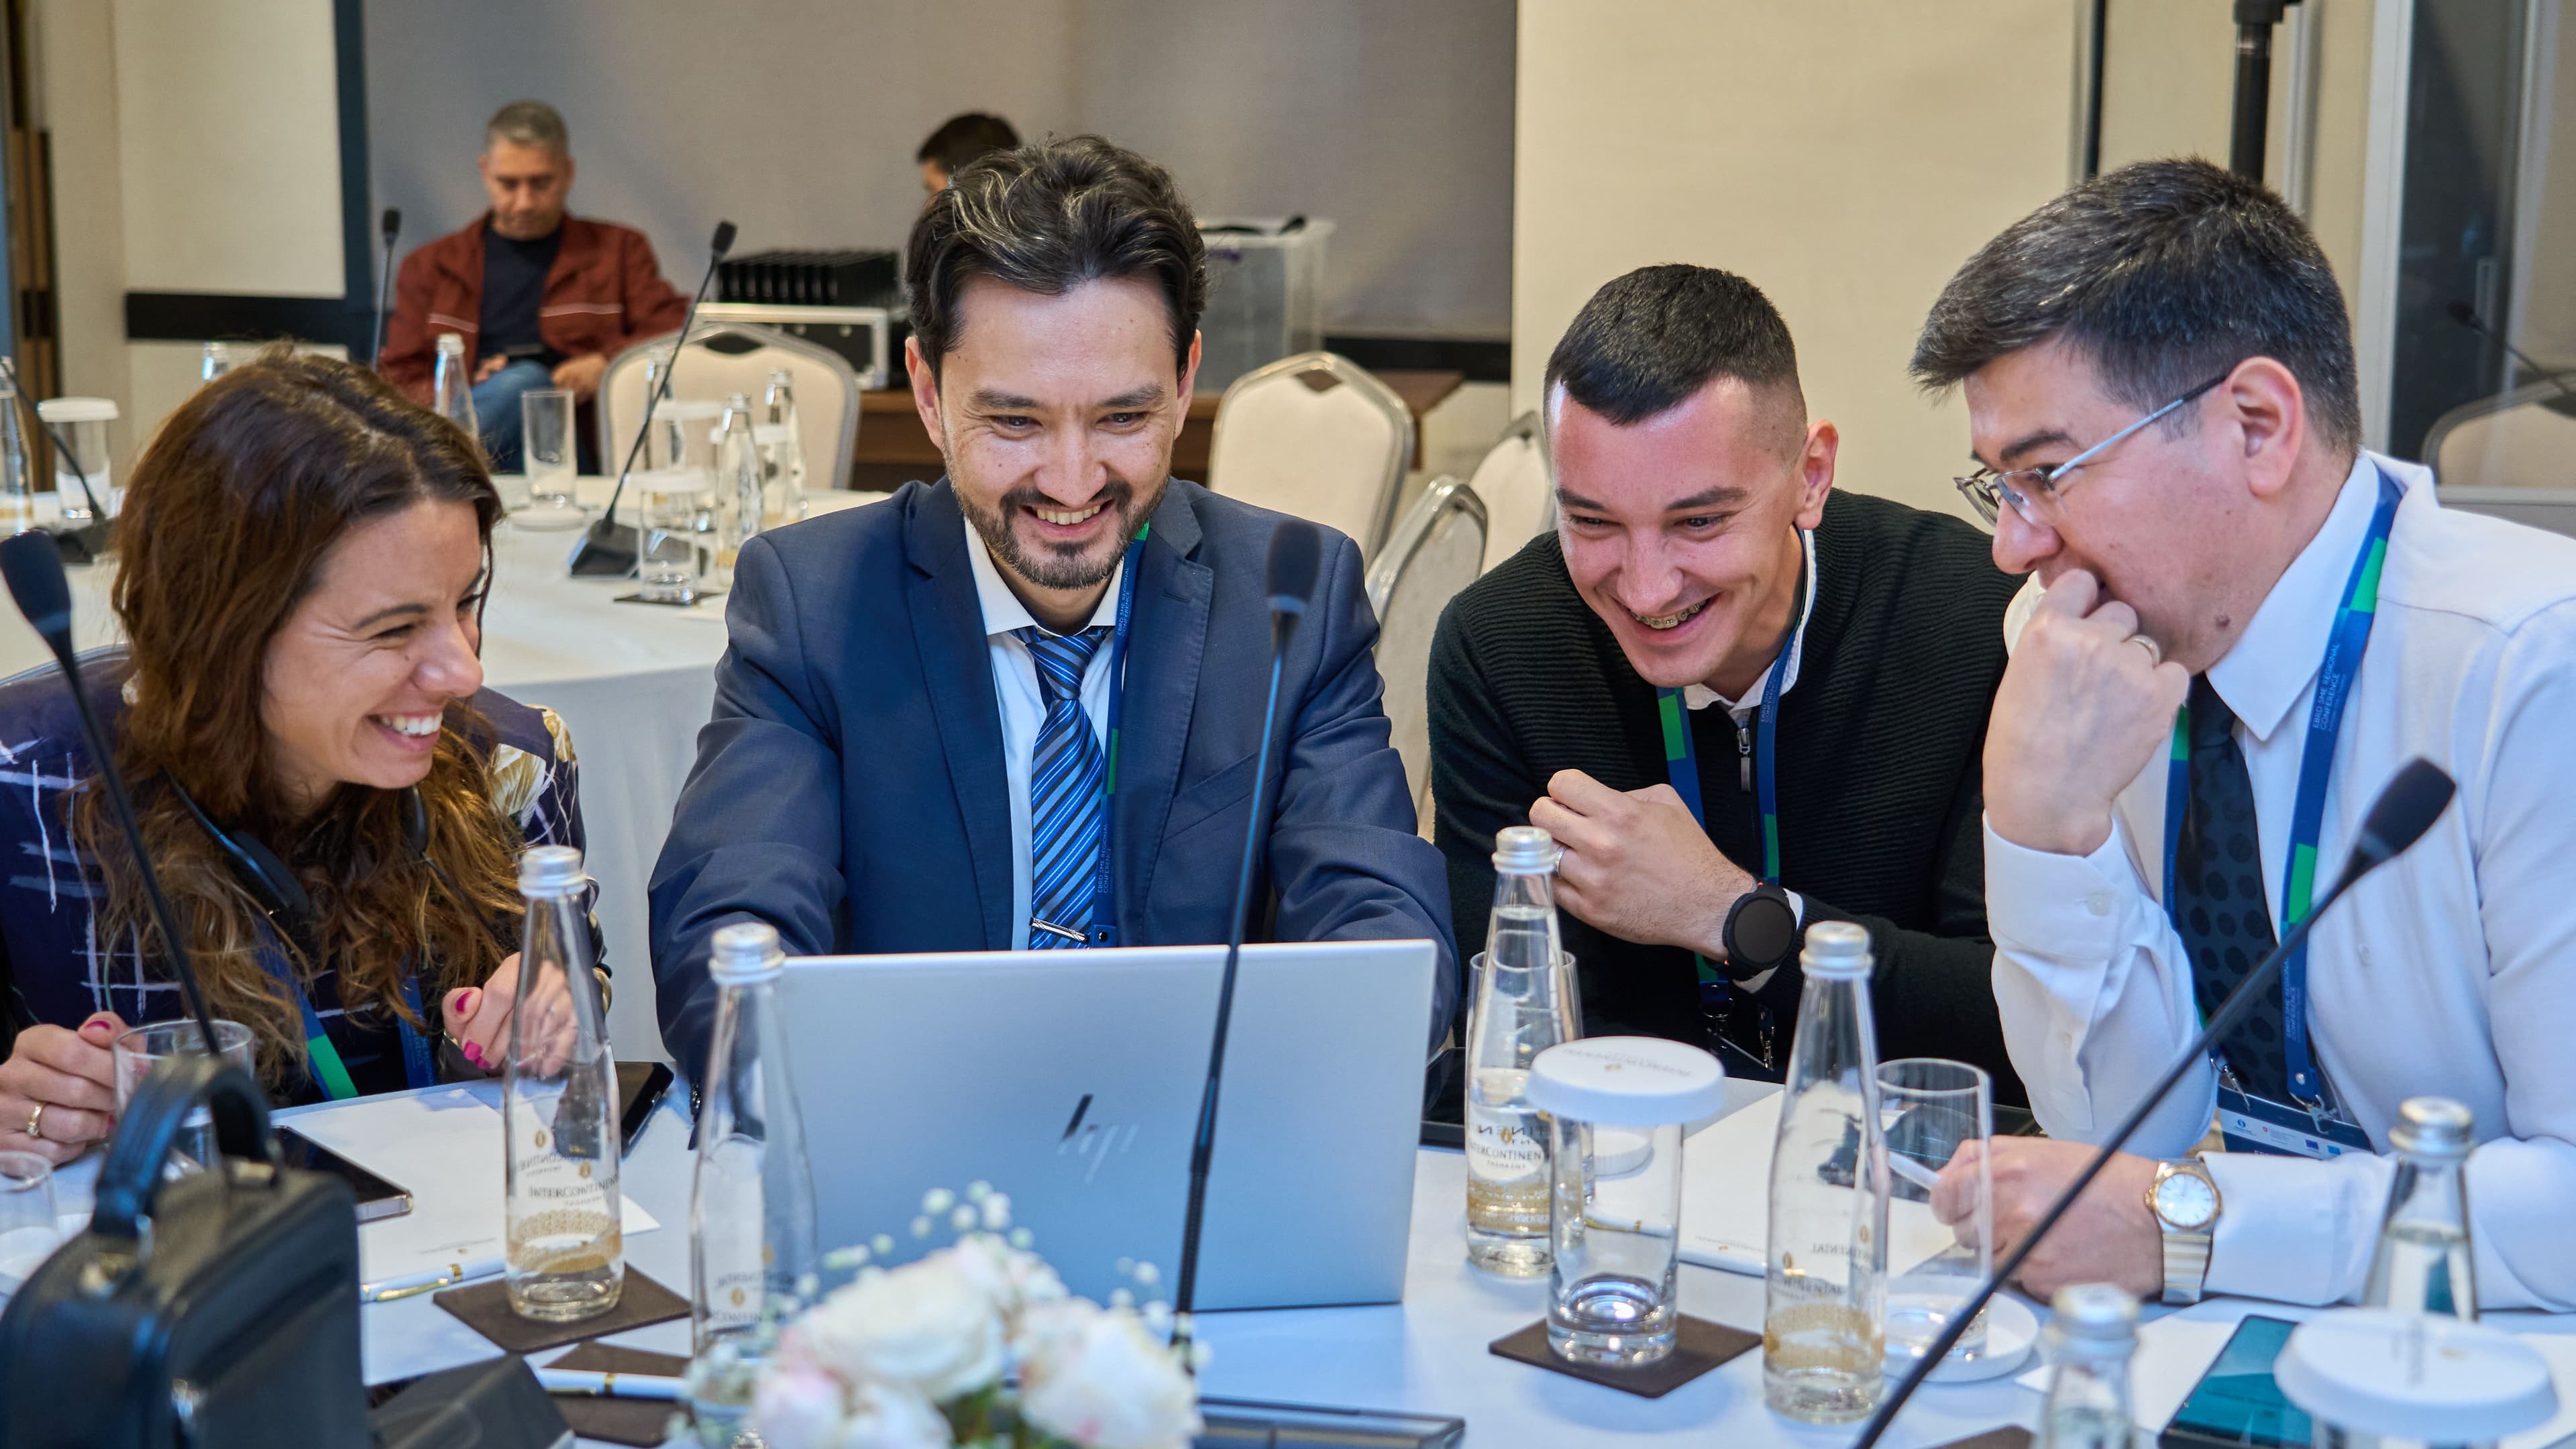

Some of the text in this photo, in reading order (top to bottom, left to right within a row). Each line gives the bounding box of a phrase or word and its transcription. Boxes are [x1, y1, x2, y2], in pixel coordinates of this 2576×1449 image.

[2312, 706, 2322, 729] EBRD
[2318, 687, 2327, 704] SME
[2320, 673, 2340, 731] CONFERENCE
[1057, 1093, 1139, 1185] hp
